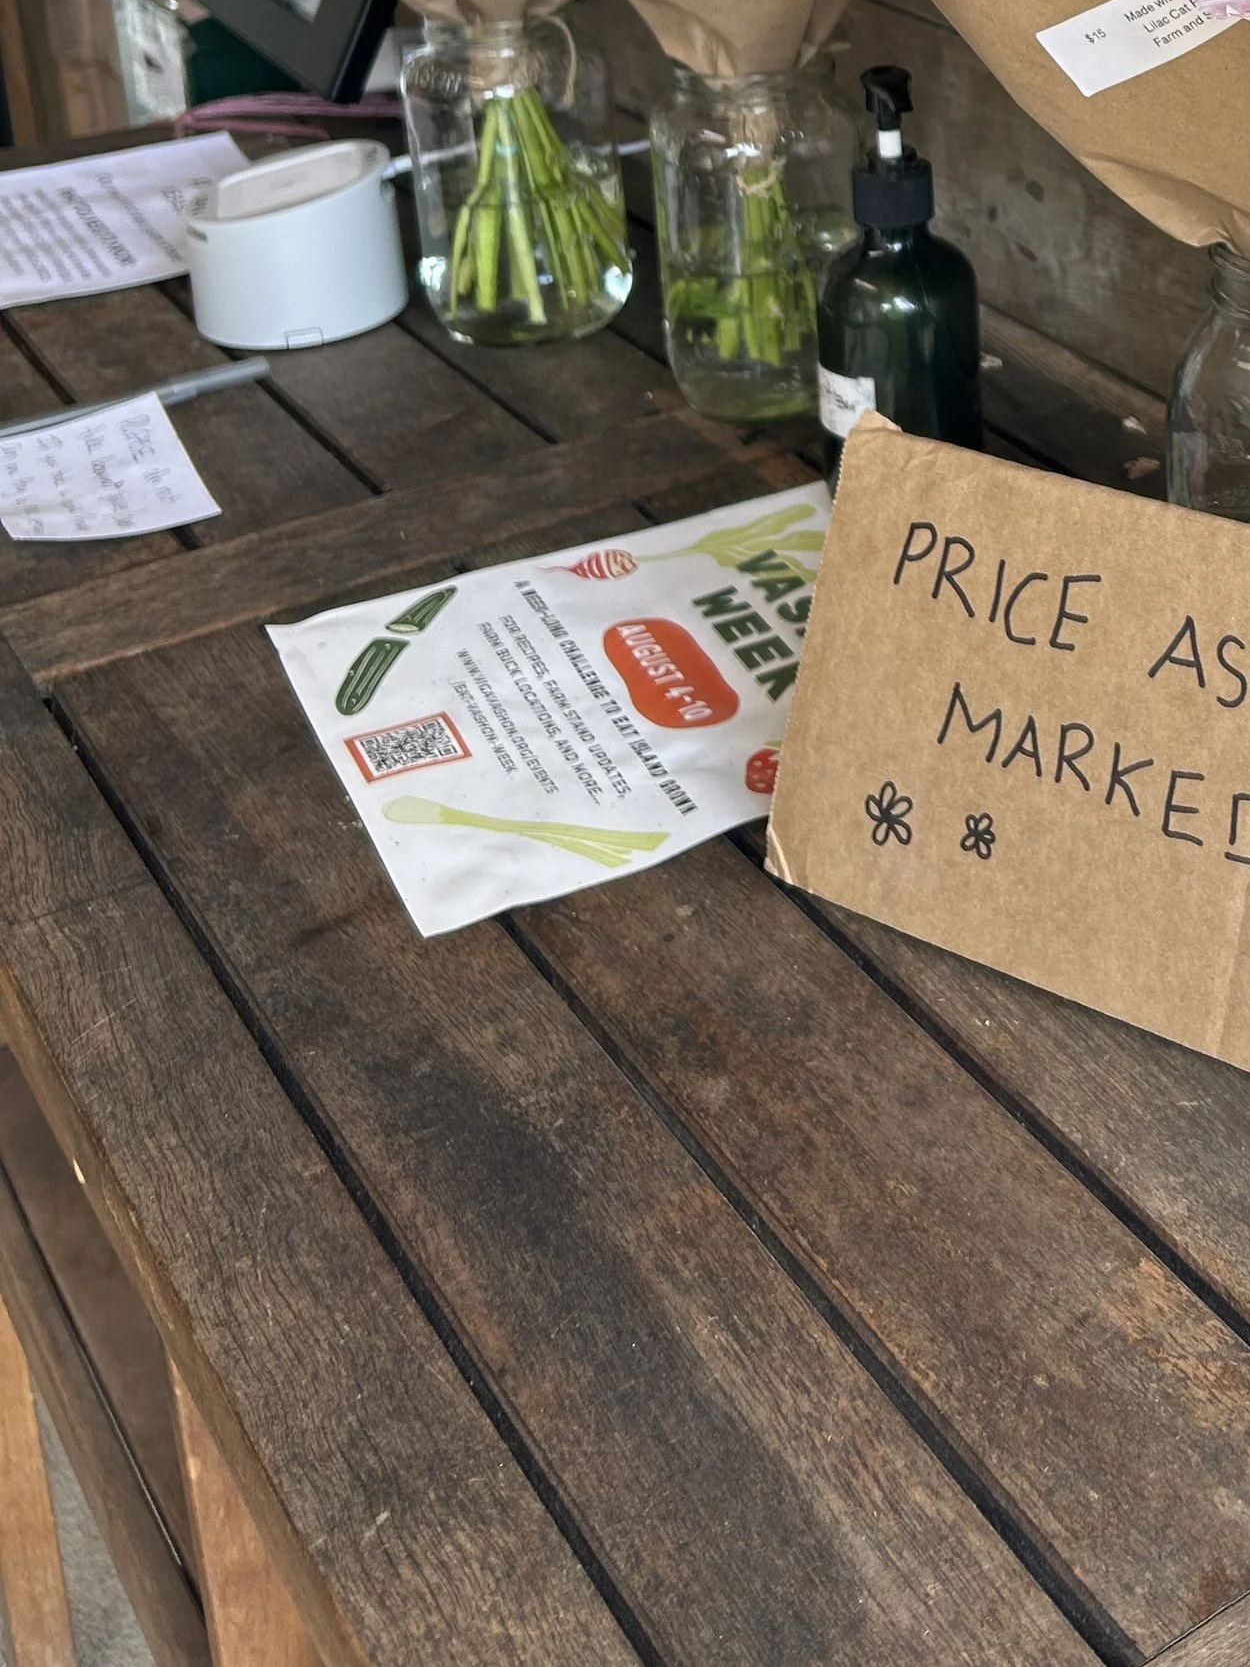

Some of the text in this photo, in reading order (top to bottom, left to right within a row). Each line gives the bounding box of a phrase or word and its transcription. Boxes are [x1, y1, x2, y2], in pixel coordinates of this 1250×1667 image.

[1085, 28, 1107, 45] $15
[1124, 5, 1156, 23] Made
[1143, 16, 1171, 34] Lilac
[1169, 1, 1193, 20] Cat
[1153, 16, 1206, 48] Farm and
[735, 548, 812, 638] VAS
[892, 521, 1249, 709] PRICE AS
[476, 620, 505, 651] FARM
[495, 646, 525, 679] BUCK
[513, 676, 563, 741] LOCATIONS,
[553, 738, 581, 763] AND
[499, 614, 522, 637] FOR
[542, 678, 572, 711] FARM
[562, 708, 597, 744] STAND
[587, 742, 633, 800] UPDATES,
[615, 623, 714, 721] AUGUST 4-10
[558, 638, 612, 701] CHALLENGE
[600, 698, 622, 715] TO
[611, 714, 641, 738] EAT
[628, 738, 669, 778] ISLAND
[658, 778, 700, 816] GROWN
